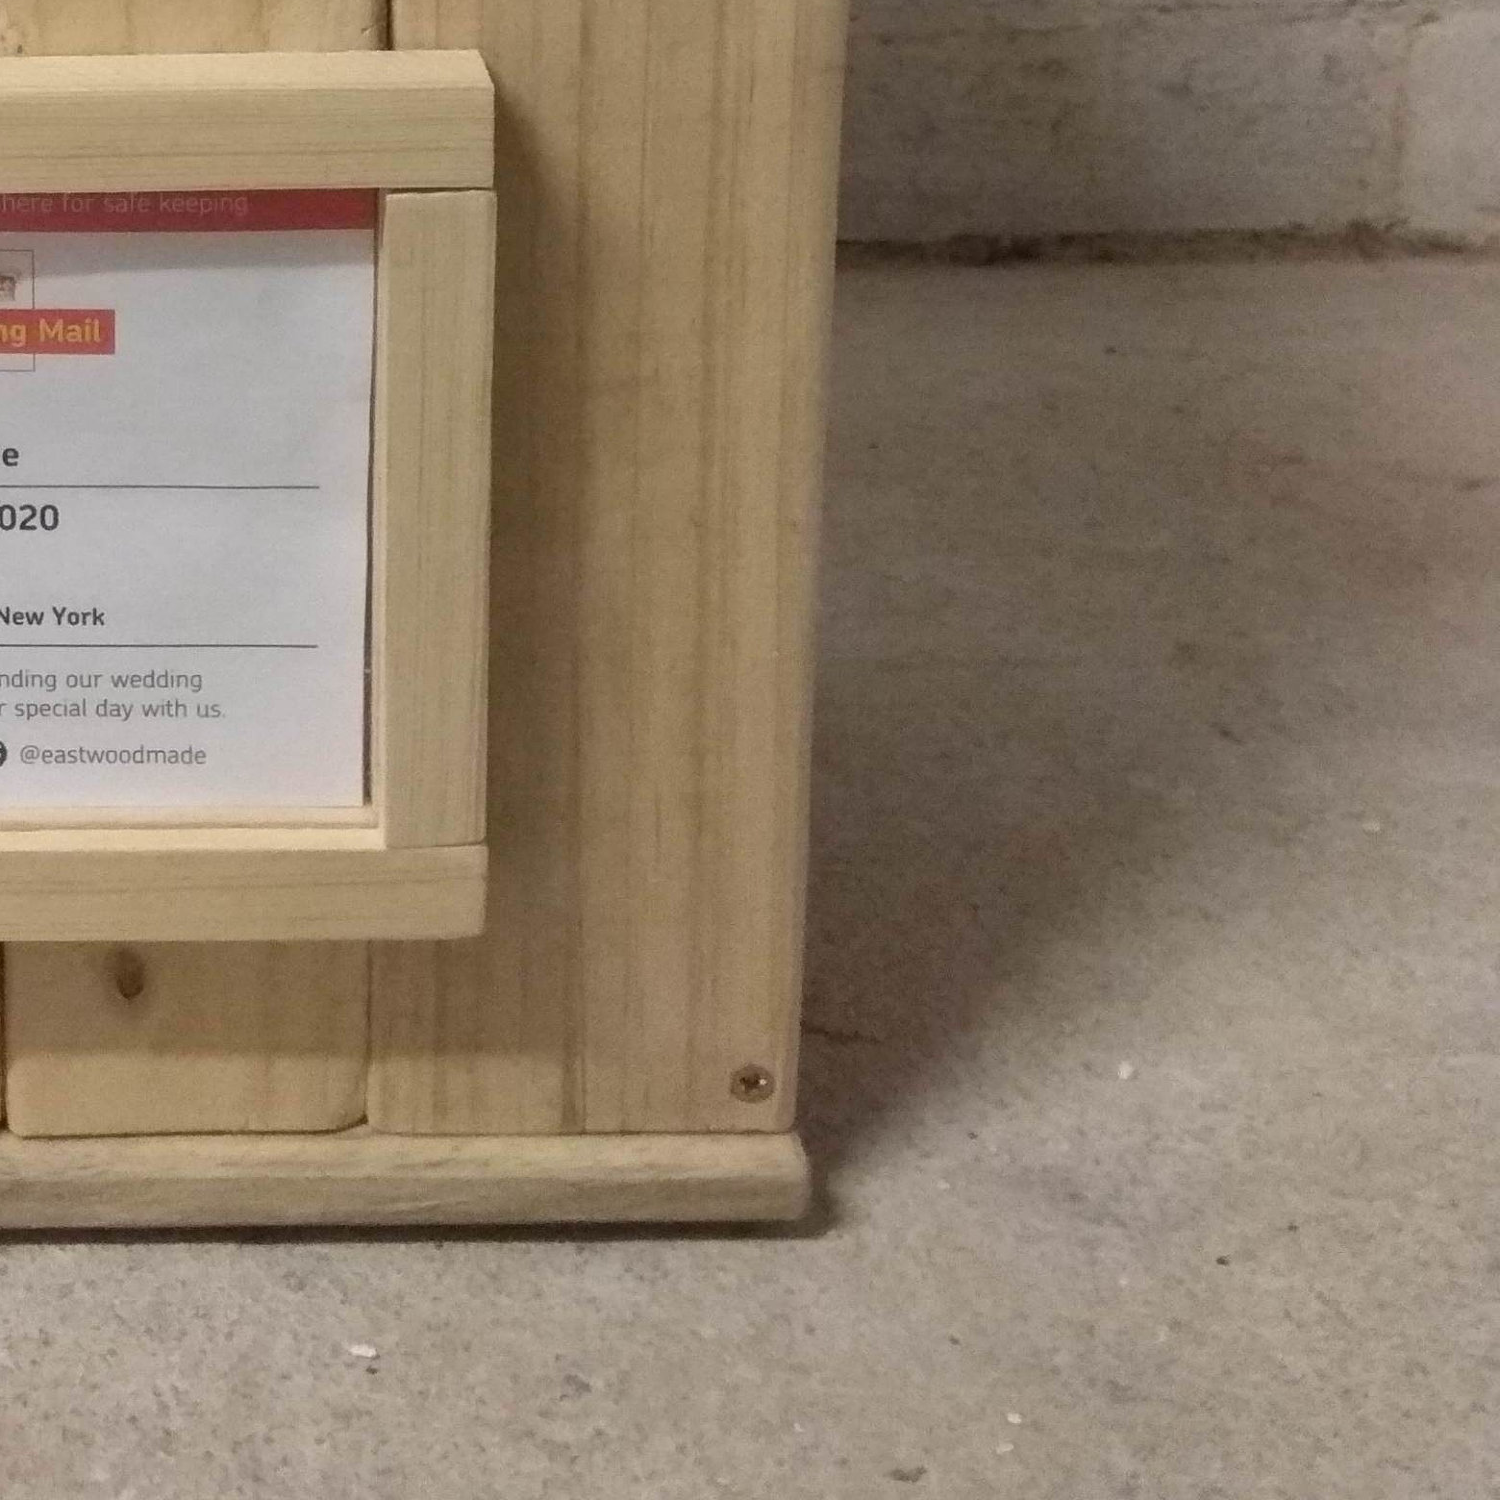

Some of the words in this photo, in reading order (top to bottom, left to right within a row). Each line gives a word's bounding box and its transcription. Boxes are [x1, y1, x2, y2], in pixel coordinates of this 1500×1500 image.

[158, 192, 249, 217] keeping
[39, 317, 102, 343] Mail
[52, 606, 106, 626] York
[65, 672, 103, 688] our
[110, 669, 203, 692] wedding
[14, 698, 87, 721] special
[95, 699, 134, 721] day
[142, 699, 188, 718] with
[195, 701, 226, 718] us.
[19, 745, 207, 766] @eastwoodmade
